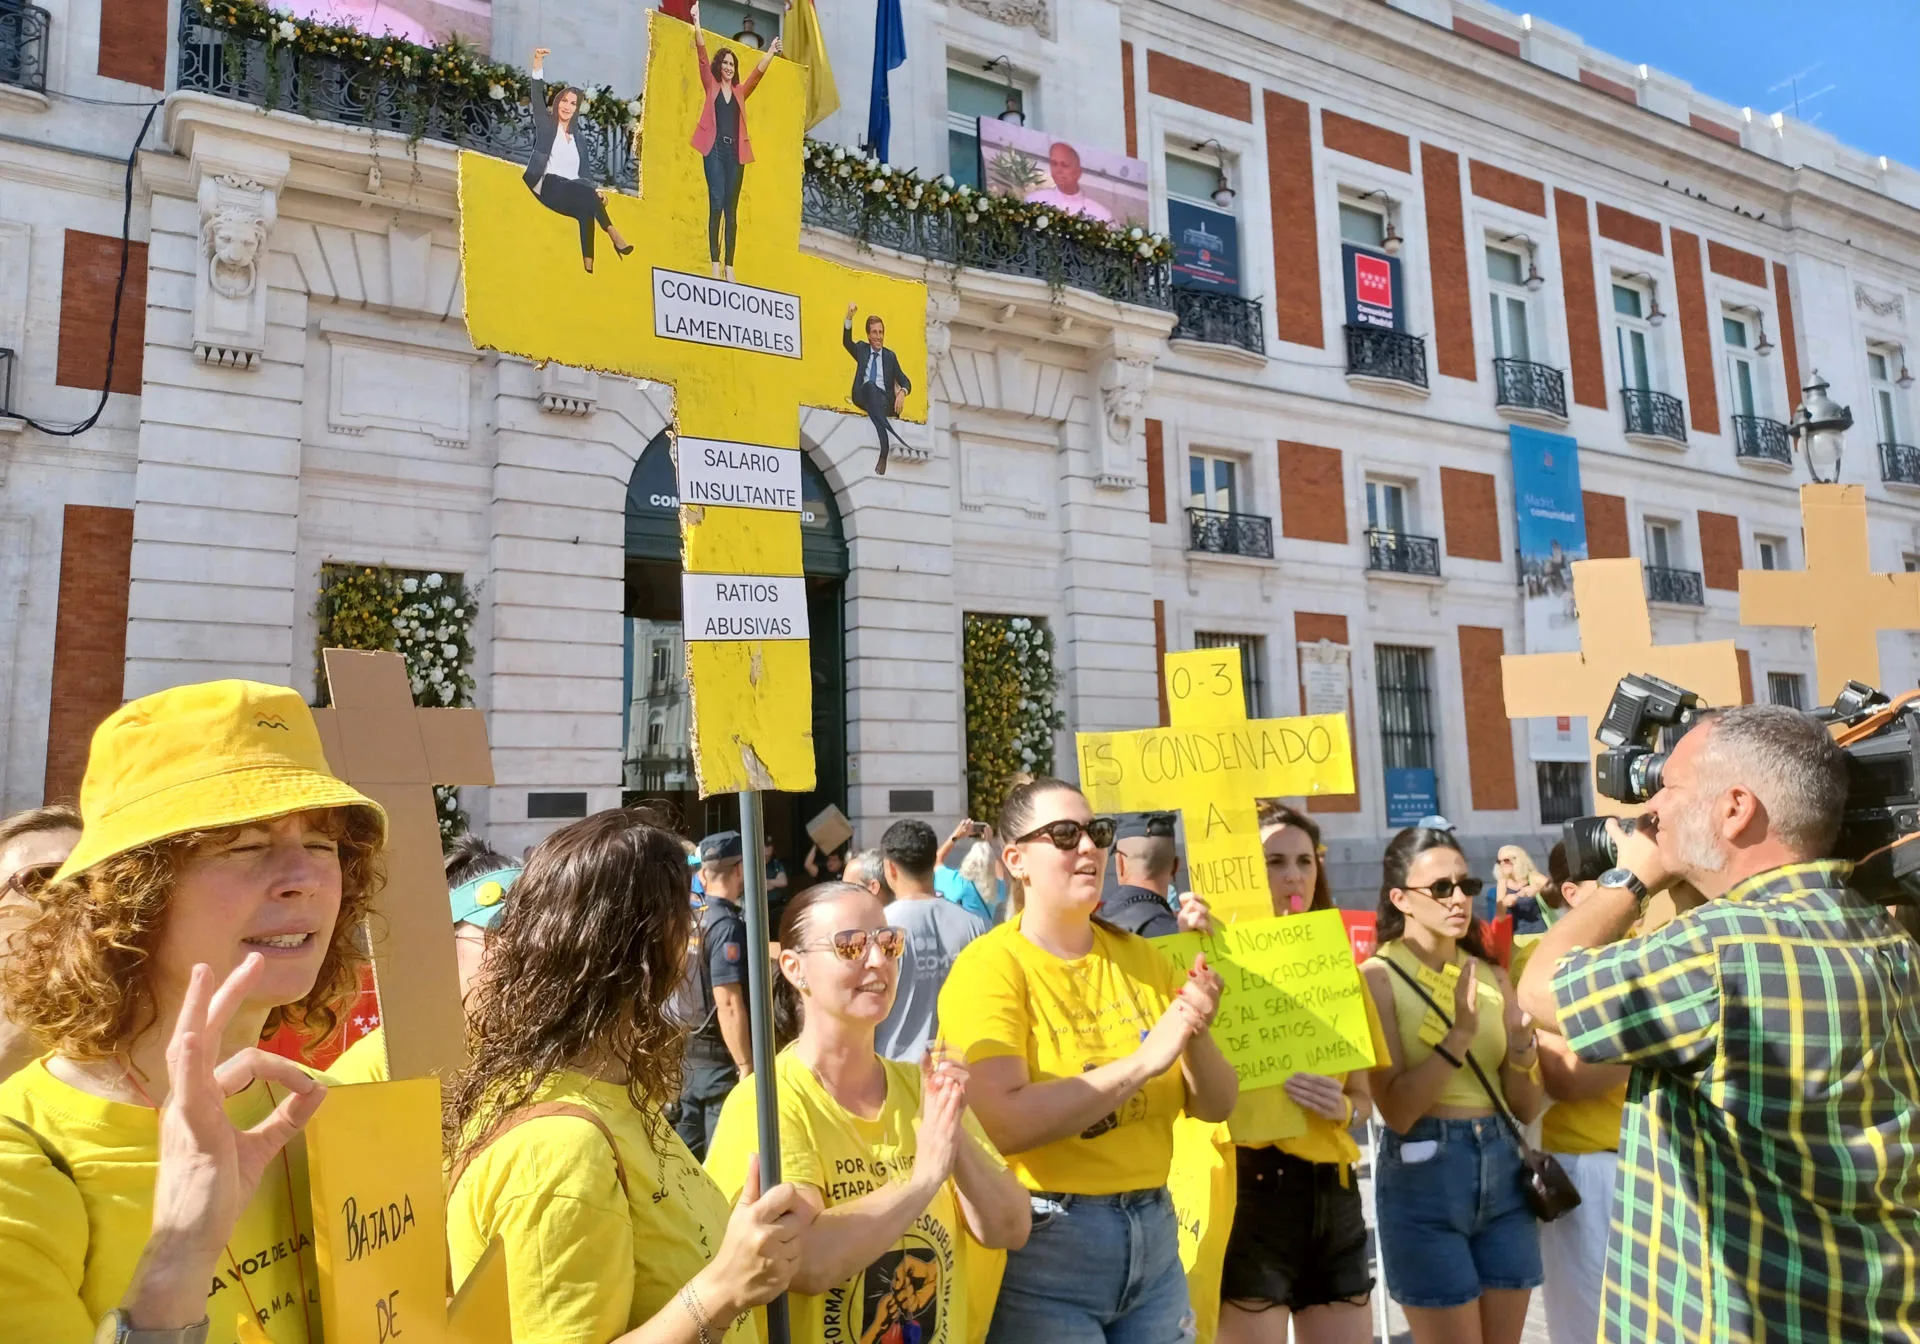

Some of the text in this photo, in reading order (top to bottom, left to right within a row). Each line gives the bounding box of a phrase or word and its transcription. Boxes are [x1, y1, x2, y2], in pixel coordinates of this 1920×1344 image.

[661, 279, 795, 321] CONDICIONES
[665, 314, 794, 352] LAMENTABLES
[704, 449, 780, 473] SALARIO
[690, 481, 796, 507] INSULTANTE
[716, 583, 779, 603] RATIOS
[705, 617, 792, 636] ABUSIVAS
[1082, 725, 1332, 787] ES CONDENADO
[1205, 803, 1232, 838] A
[1191, 855, 1261, 896] MUERTE
[1235, 923, 1316, 955] NOMBRE
[1240, 950, 1353, 992] EDUCADORAS
[1226, 1013, 1339, 1052] DE RATIOS Y
[1233, 1053, 1293, 1082] SALARIO
[836, 1158, 866, 1175] POR
[341, 1192, 416, 1262] BAJADA
[227, 1250, 272, 1282] VOZ
[271, 1241, 288, 1262] DE
[288, 1233, 311, 1254] LA
[375, 1289, 403, 1344] DE
